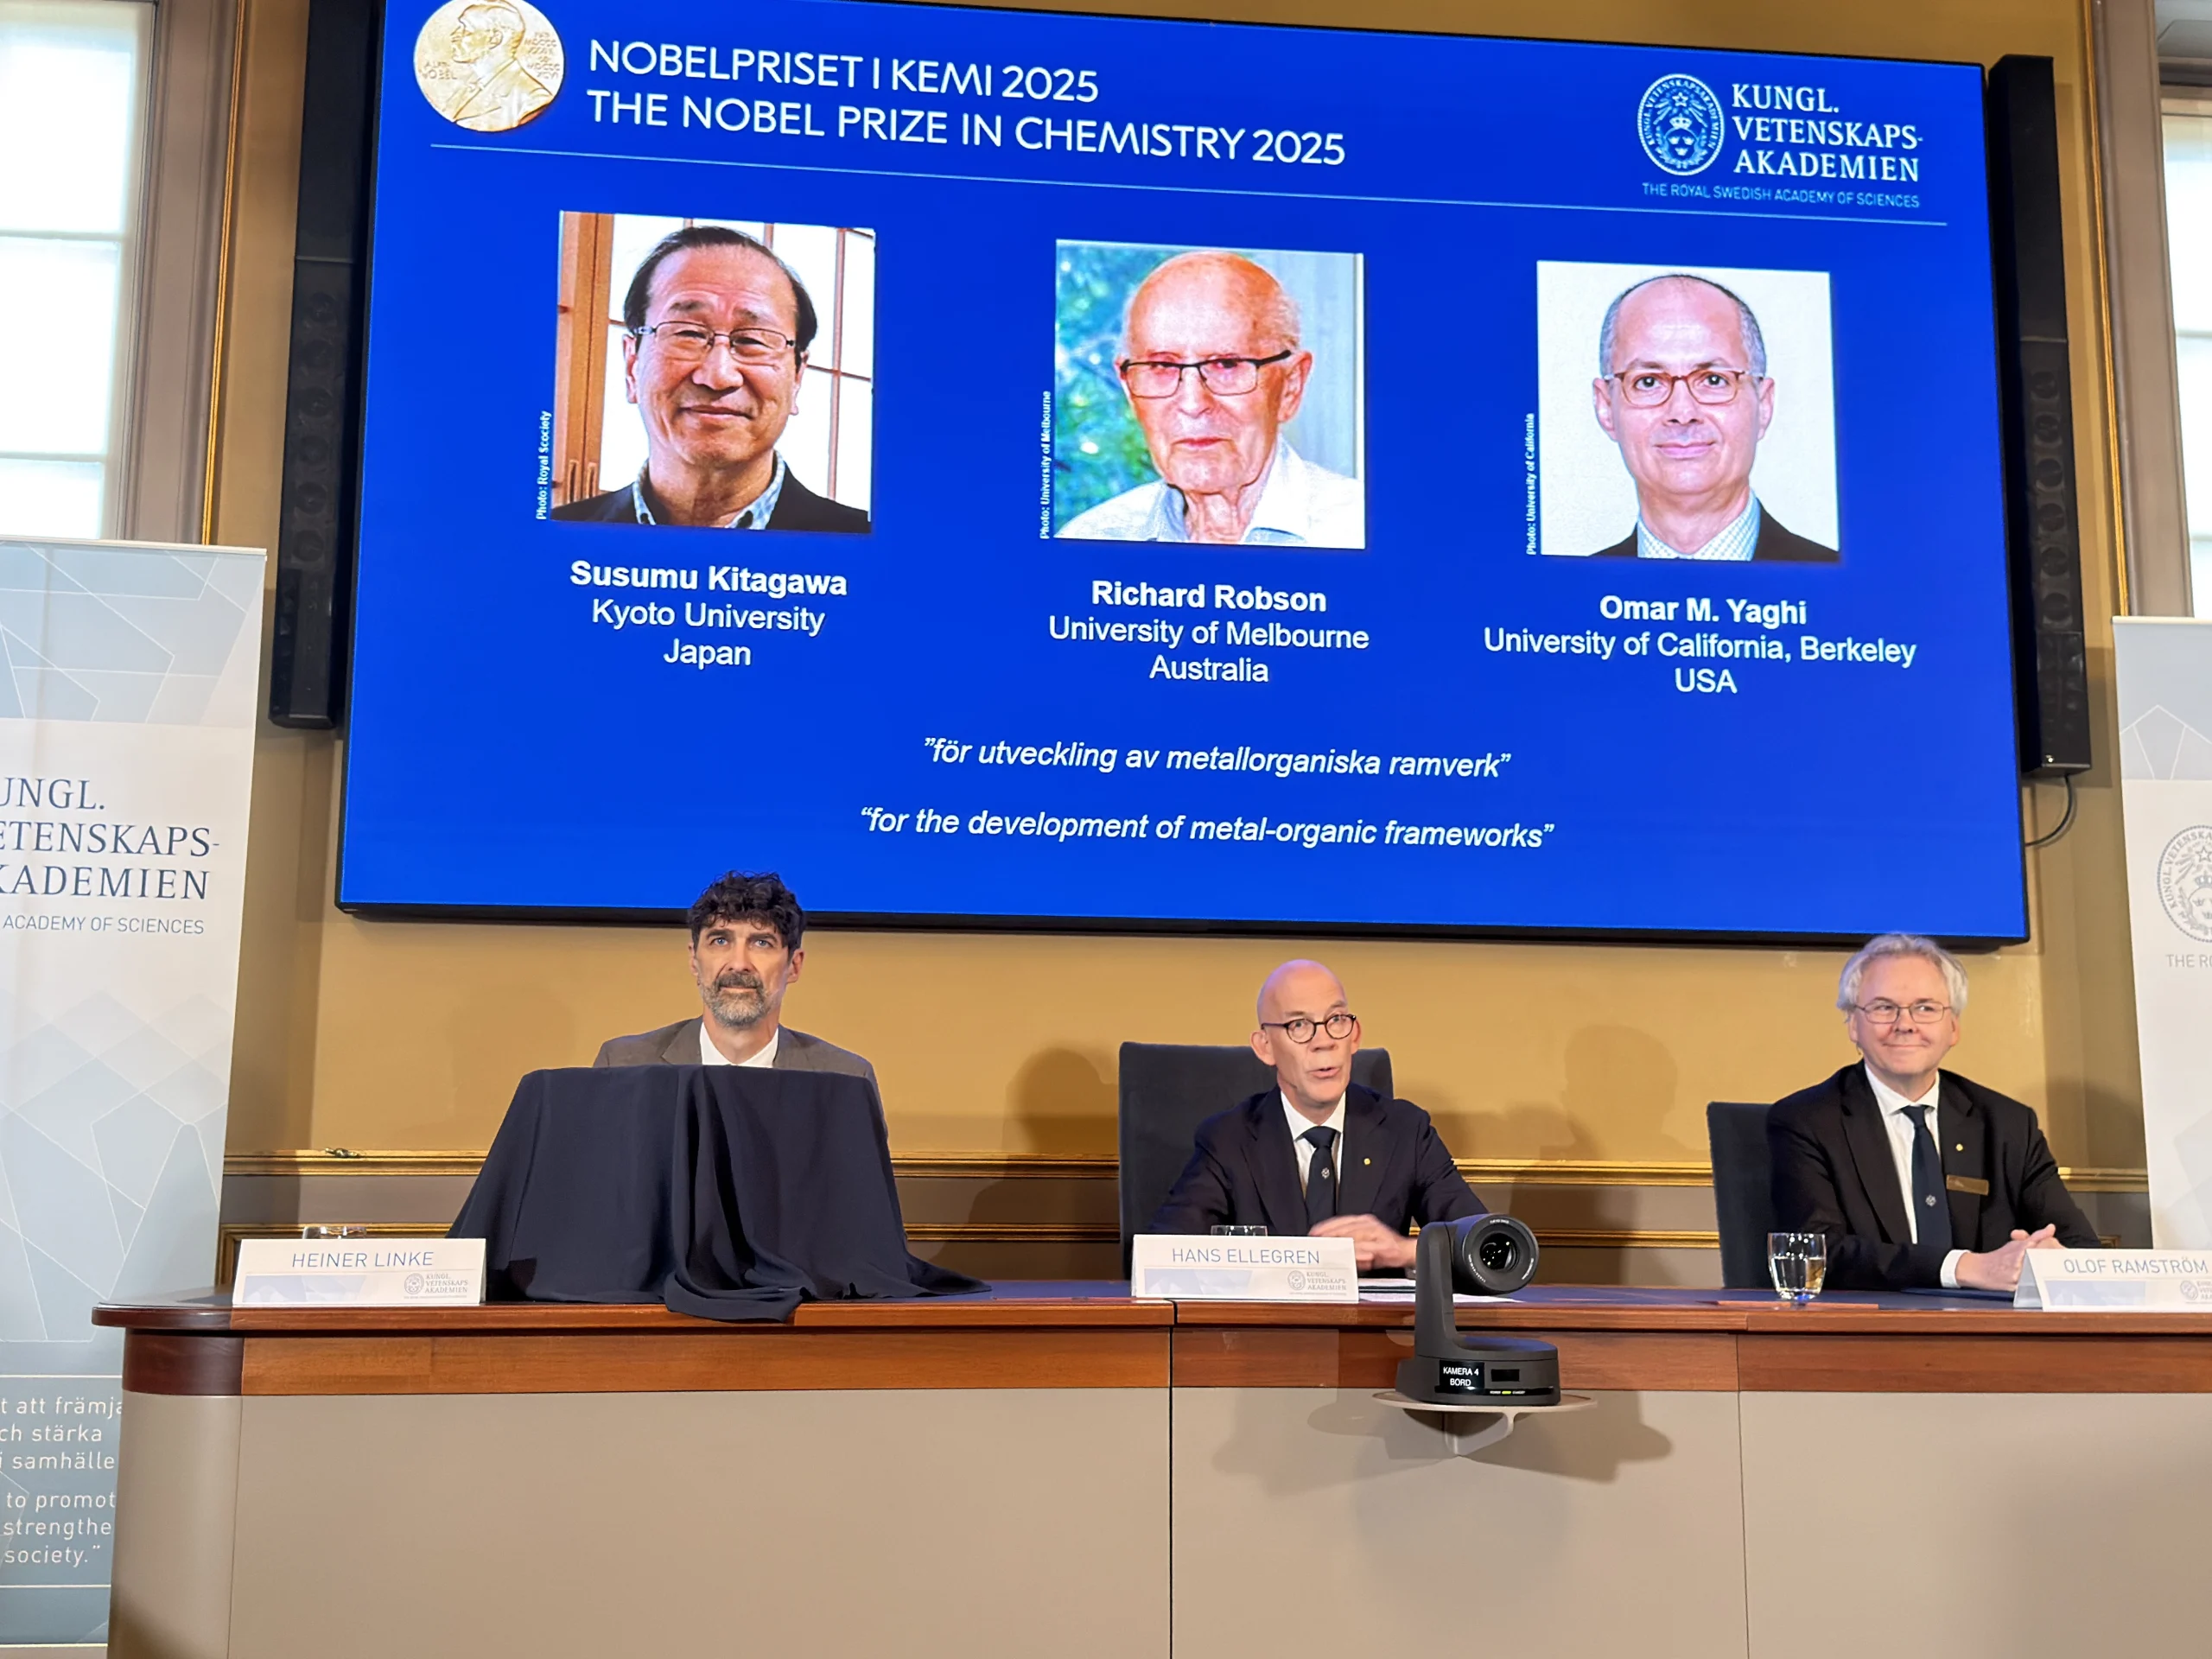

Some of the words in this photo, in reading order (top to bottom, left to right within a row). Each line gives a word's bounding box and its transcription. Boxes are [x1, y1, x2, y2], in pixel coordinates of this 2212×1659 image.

[590, 39, 864, 88] NOBELPRISET
[873, 57, 880, 90] I
[892, 58, 992, 97] KEMI
[1001, 65, 1098, 103] 2025
[1732, 83, 1840, 113] KUNGL.
[587, 89, 669, 127] THE
[683, 95, 825, 137] NOBEL
[838, 105, 948, 144] PRIZE
[963, 112, 1001, 147] IN
[1015, 117, 1246, 160] CHEMISTRY
[1252, 129, 1345, 166] 2025
[1732, 116, 1923, 149] VETENSKAPS-
[1733, 149, 1918, 182] AKADEMIEN
[1642, 182, 1668, 197] THE
[1670, 183, 1711, 199] ROYAL
[1713, 185, 1771, 200] SWEDISH
[1774, 188, 1834, 203] ACADEMY
[1837, 191, 1853, 205] OF
[1856, 192, 1920, 208] SCIENCES
[1039, 389, 1052, 444] Melbourne
[1040, 442, 1052, 455] of
[1524, 411, 1536, 461] California
[537, 454, 551, 486] Royal
[1039, 455, 1053, 506] University
[1525, 459, 1535, 473] of
[535, 486, 550, 521] Photo:
[1525, 473, 1537, 523] University
[1039, 506, 1051, 540] Photo:
[1525, 522, 1537, 556] Photo:
[569, 560, 698, 590] Susumu
[709, 565, 848, 599] Kitagawa
[1092, 580, 1205, 608] Richard
[1214, 584, 1326, 613] Robson
[1599, 594, 1680, 621] Omar
[1686, 597, 1719, 622] M.
[1726, 598, 1807, 630] Yaghi
[592, 598, 676, 630] Kyoto
[684, 601, 826, 638] University
[1049, 615, 1184, 649] University
[1192, 620, 1220, 645] of
[1226, 620, 1370, 649] Melbourne
[663, 638, 751, 671] Japan
[1484, 626, 1617, 660] University
[1623, 631, 1650, 656] of
[1656, 632, 1791, 663] California,
[1800, 635, 1916, 669] Berkeley
[1149, 654, 1269, 683] Australia
[1675, 667, 1738, 694] USA
[925, 737, 973, 763] ”för
[978, 740, 1118, 773] utveckling
[1125, 749, 1160, 768] av
[1166, 746, 1381, 778] metallorganiska
[1389, 753, 1512, 778] ramverk”
[861, 806, 910, 832] “for
[915, 808, 960, 834] the
[968, 810, 1149, 842] development
[1155, 815, 1186, 839] of
[1189, 817, 1377, 849] metal-organic
[1384, 819, 1555, 848] frameworks”
[3, 914, 86, 931] ACADEMY
[90, 916, 113, 931] OF
[117, 917, 204, 935] SCIENCES
[2164, 953, 2196, 969] THE
[292, 1252, 368, 1268] HEINER
[374, 1251, 434, 1268] LINKE
[1173, 1248, 1221, 1262] HANS
[1227, 1249, 1319, 1264] ELLEGREN
[2063, 1258, 2107, 1274] OLOF
[2111, 1257, 2209, 1274] RAMSTRÖM
[1442, 1366, 1473, 1376] KAMERA
[1473, 1368, 1480, 1376] 4
[1449, 1377, 1471, 1387] BORD
[16, 1397, 46, 1414] att
[31, 1423, 102, 1442] stärka
[12, 1451, 115, 1470] samhälle
[5, 1490, 27, 1510] to
